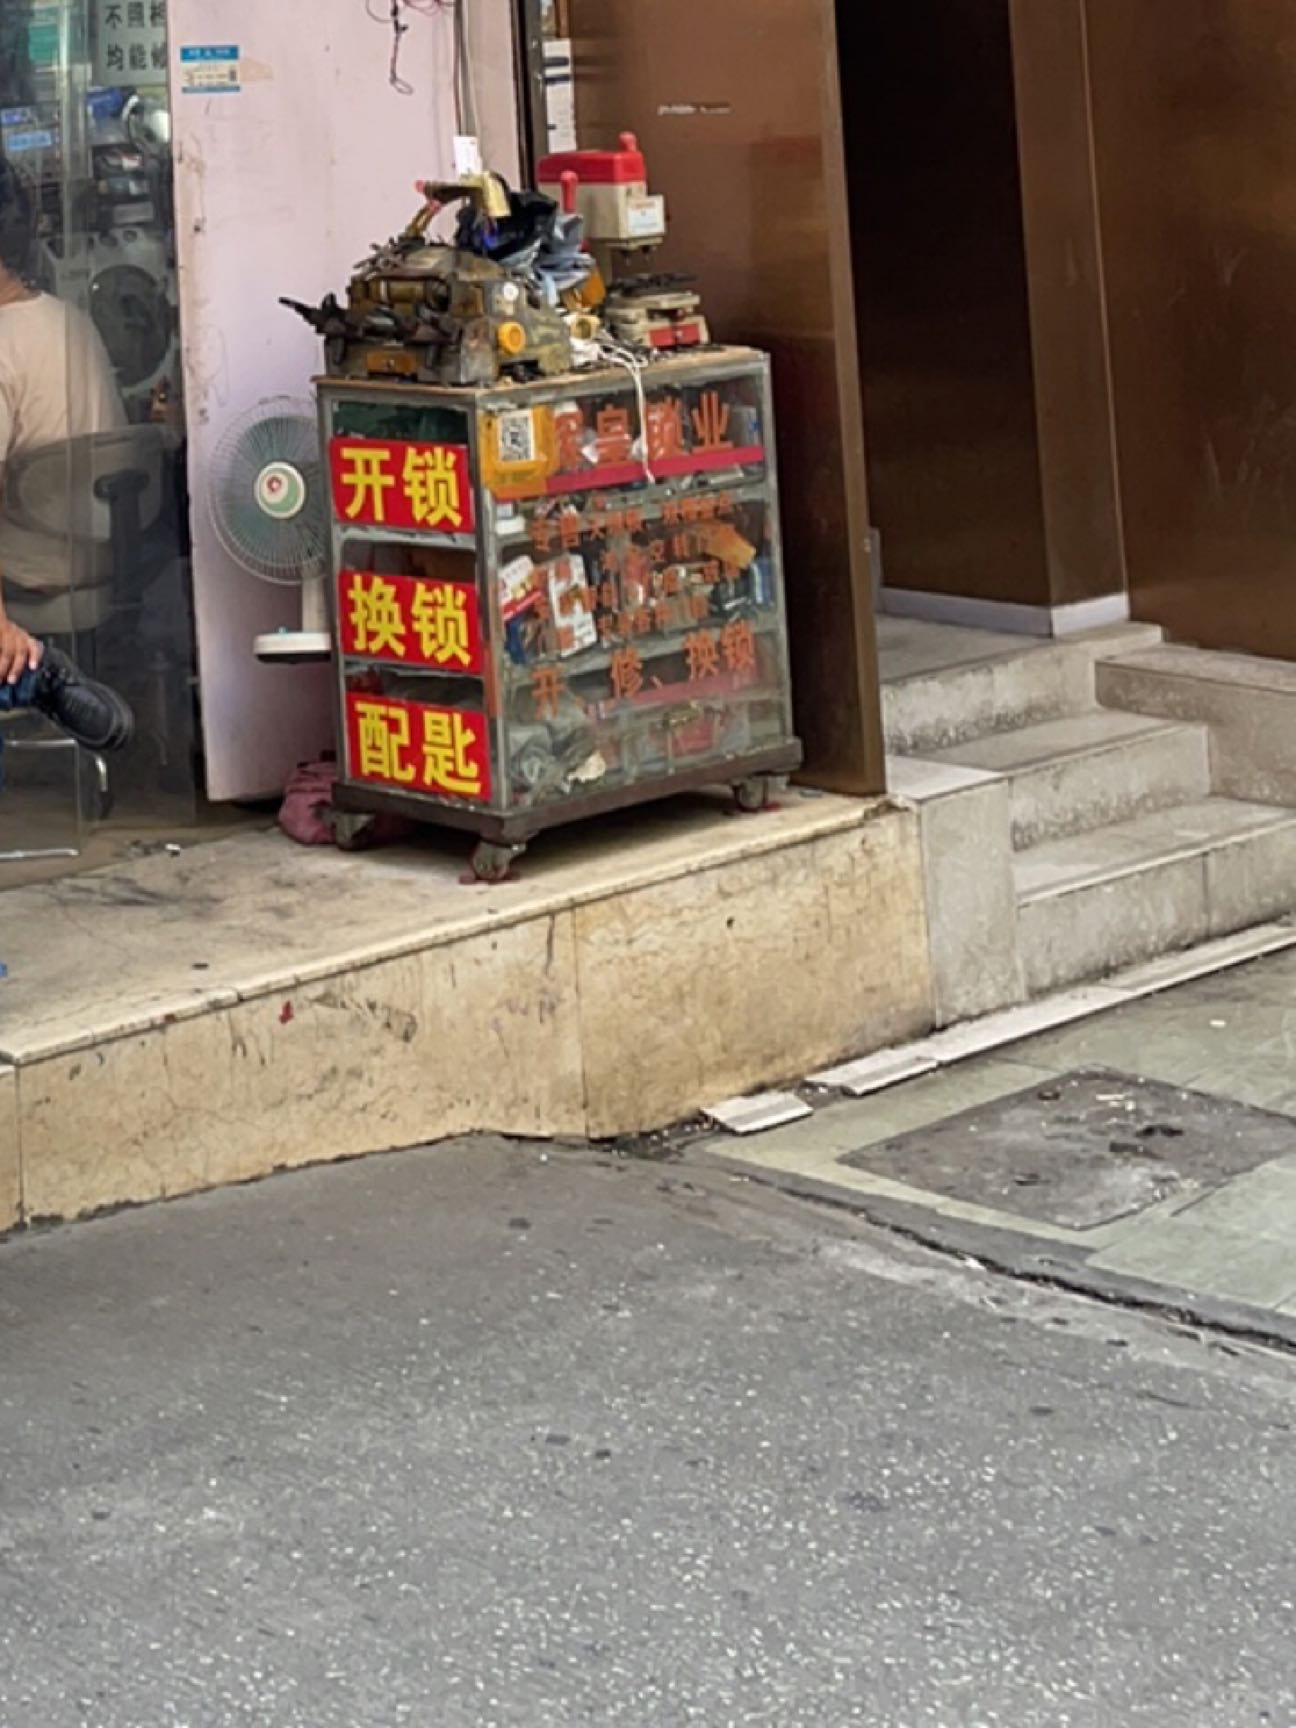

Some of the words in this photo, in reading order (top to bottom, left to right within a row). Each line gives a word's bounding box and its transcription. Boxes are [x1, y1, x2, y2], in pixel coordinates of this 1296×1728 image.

[340, 446, 463, 527] 开锁
[347, 574, 472, 667] 换锁
[355, 699, 482, 795] 配匙
